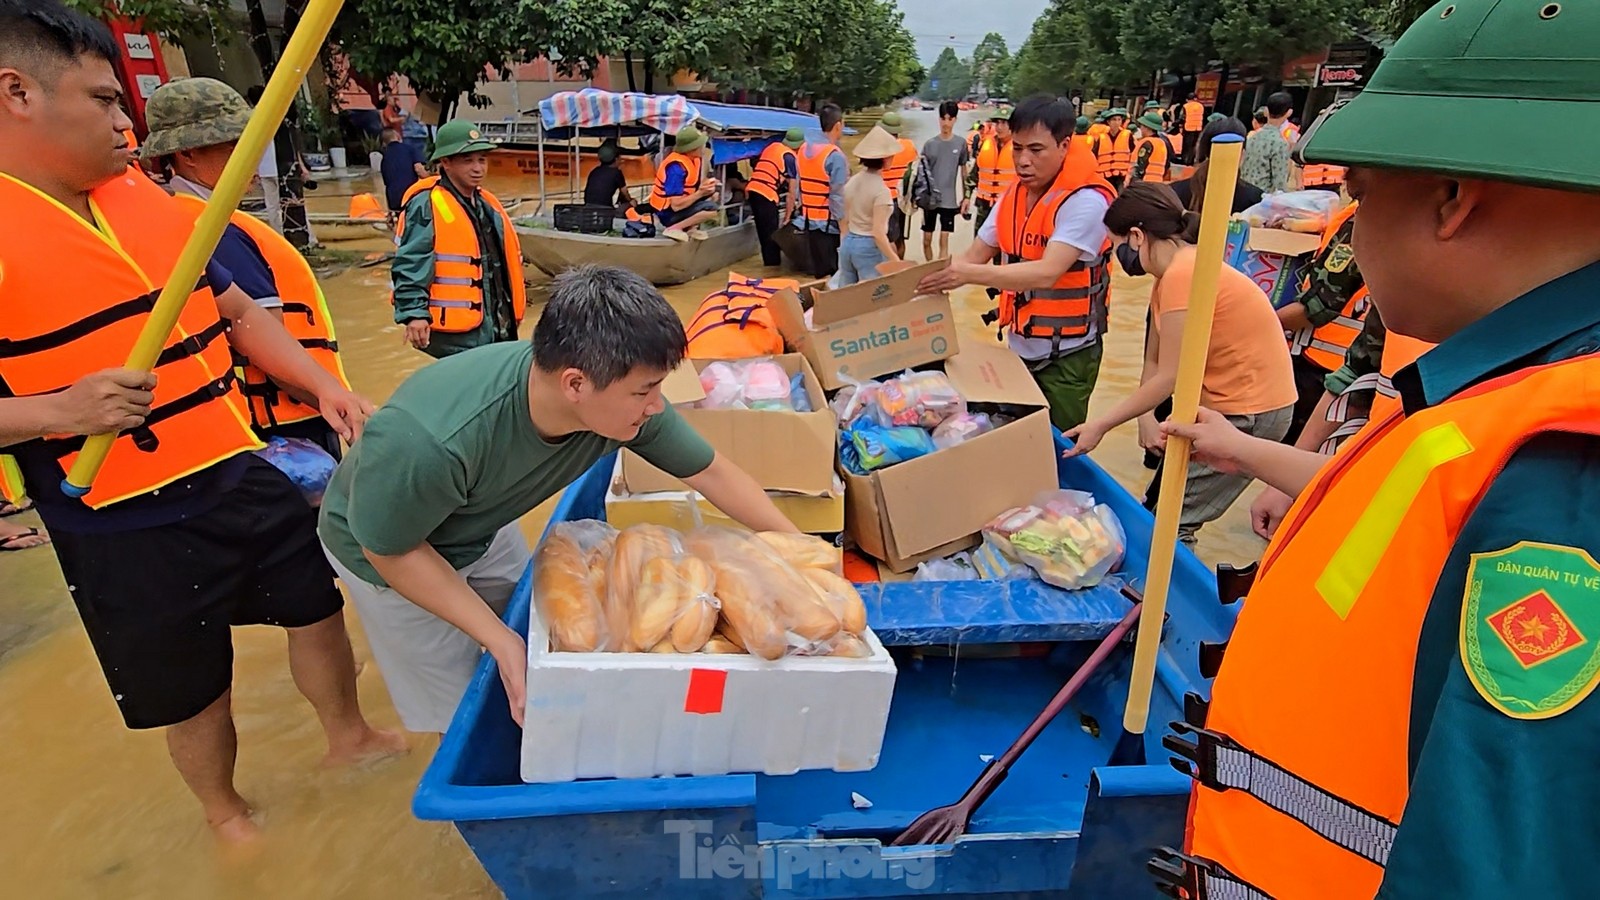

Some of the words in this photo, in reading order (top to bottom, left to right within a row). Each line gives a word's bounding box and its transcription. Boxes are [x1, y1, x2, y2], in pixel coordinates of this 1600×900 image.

[829, 325, 910, 358] Santafa
[1496, 560, 1521, 577] DÂN
[1523, 565, 1560, 582] QUÂN
[1563, 572, 1580, 588] TỰ
[1583, 575, 1600, 592] VỆ
